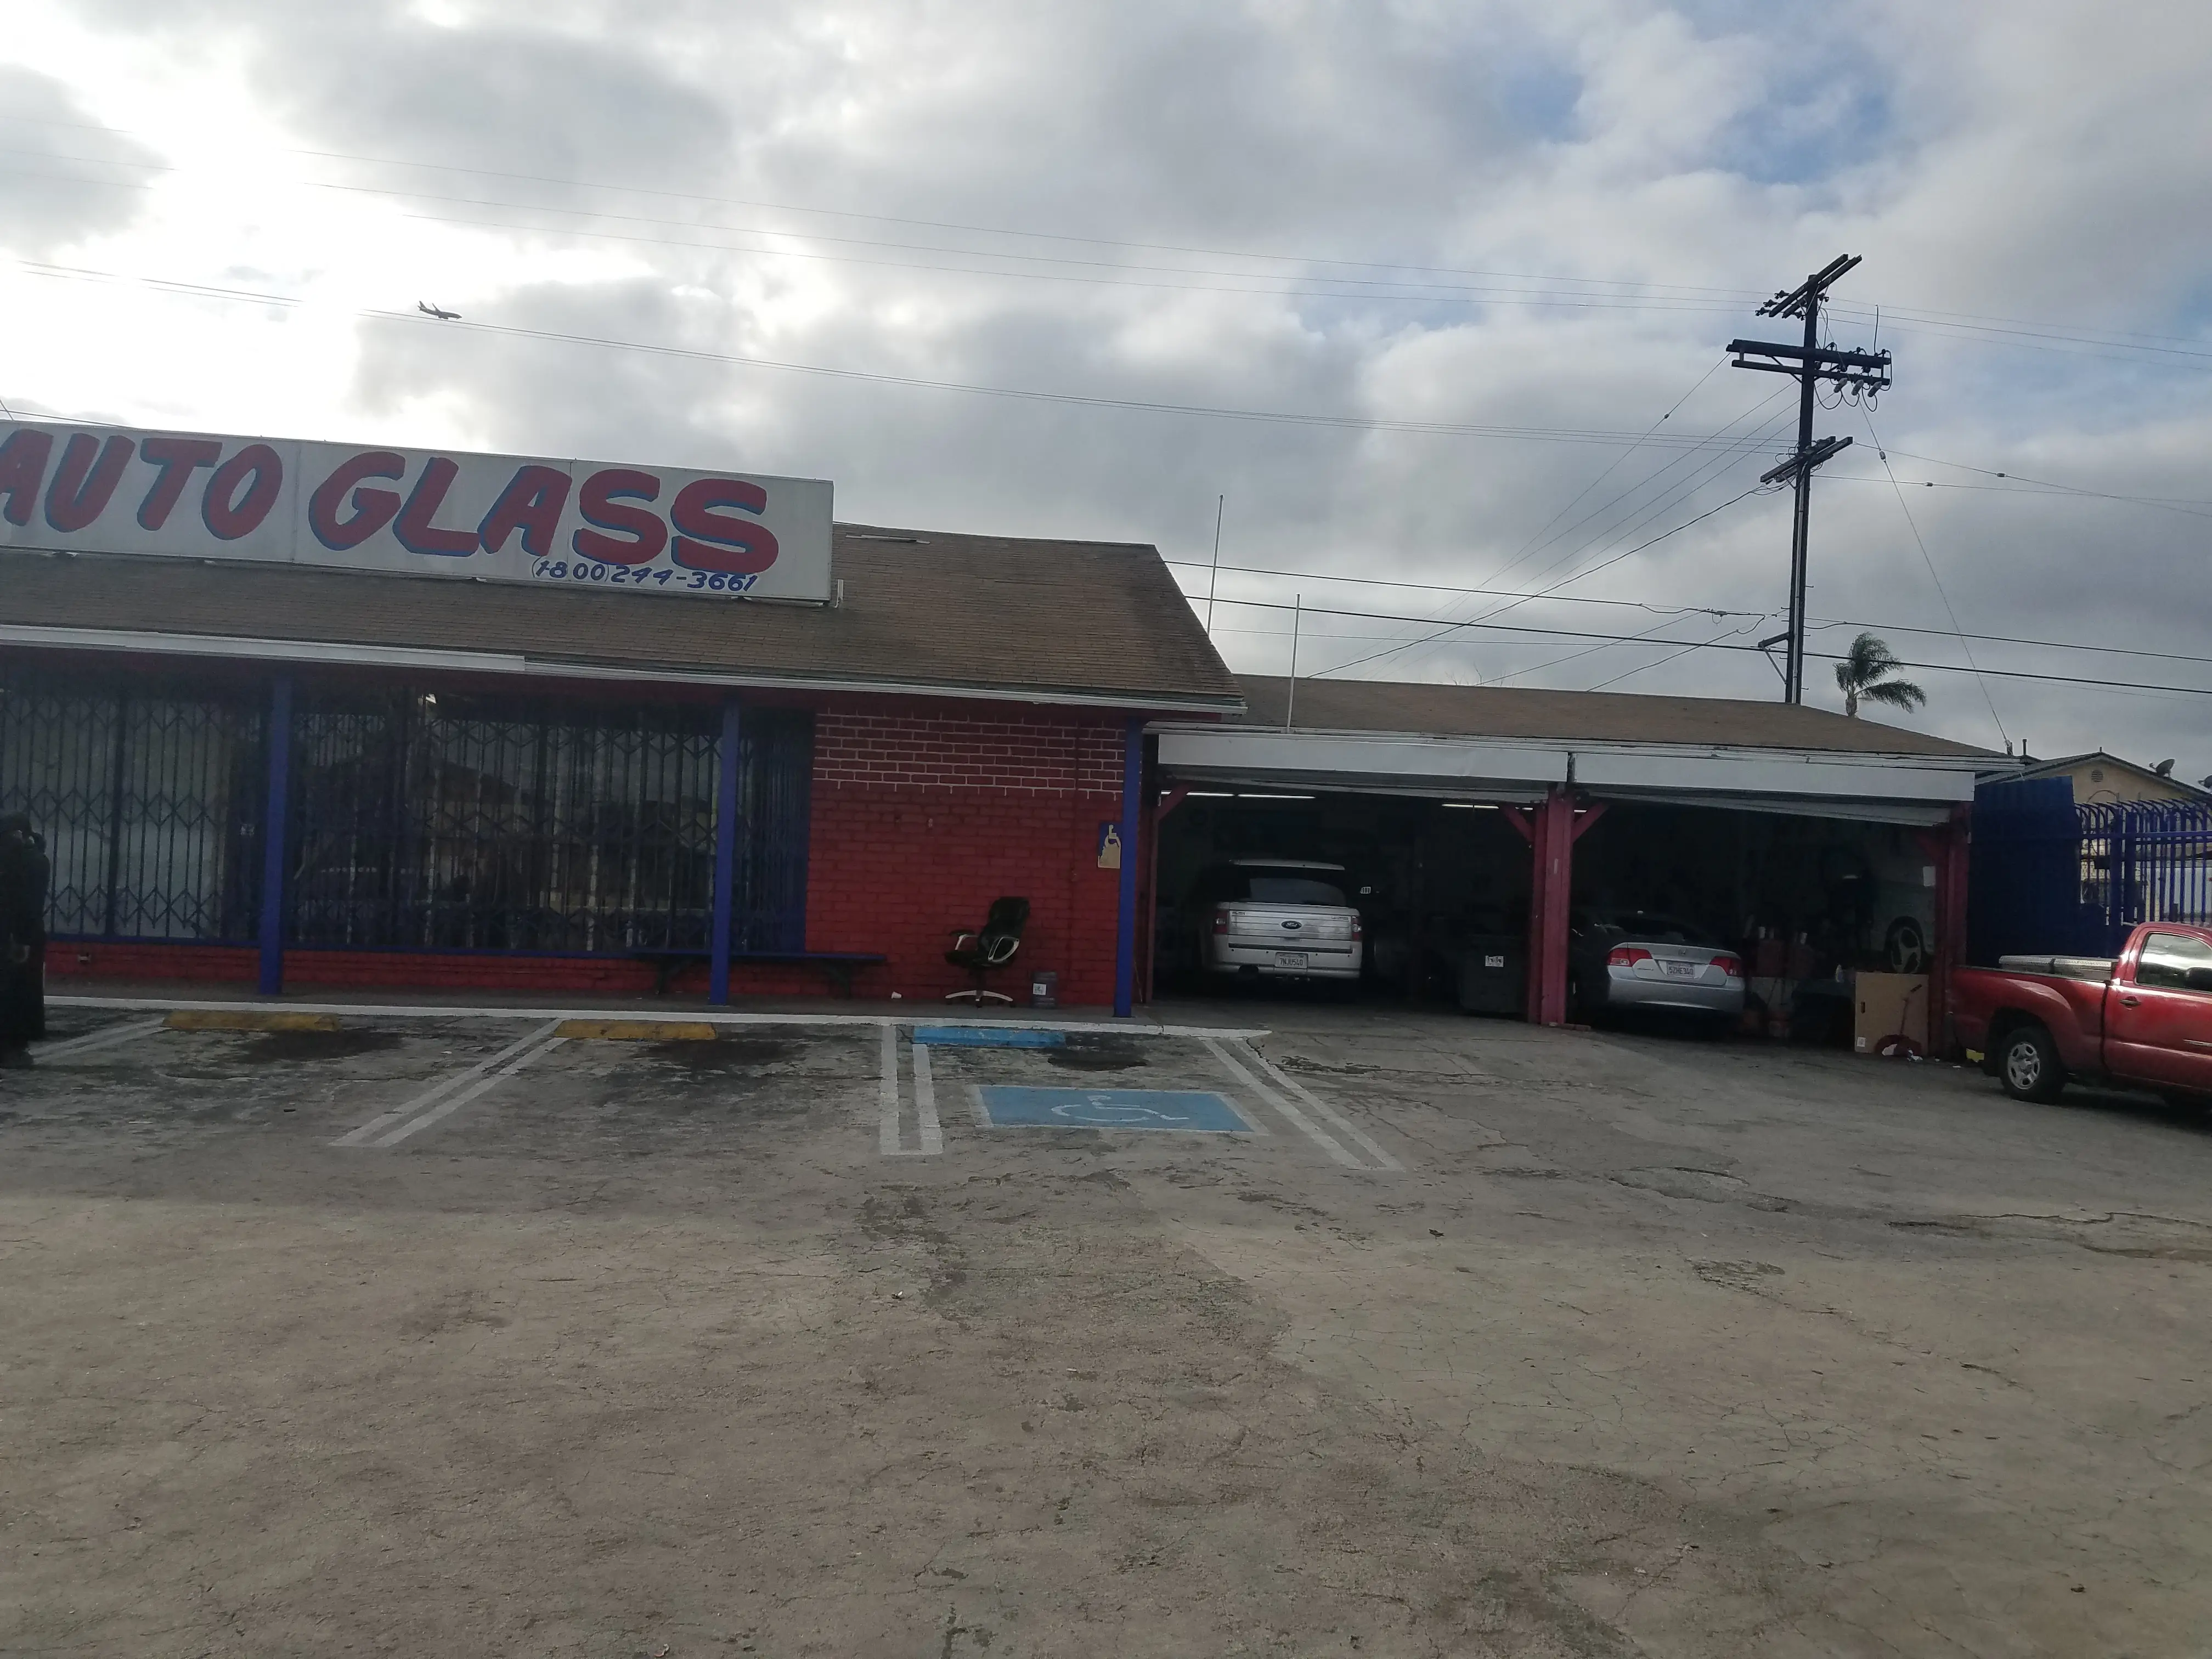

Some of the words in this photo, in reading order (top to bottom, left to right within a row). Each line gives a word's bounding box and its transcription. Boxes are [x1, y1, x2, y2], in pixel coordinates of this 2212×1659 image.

[0, 428, 283, 540] AUTO
[308, 451, 779, 574] GLASS
[1279, 958, 1303, 966] 7NJU540
